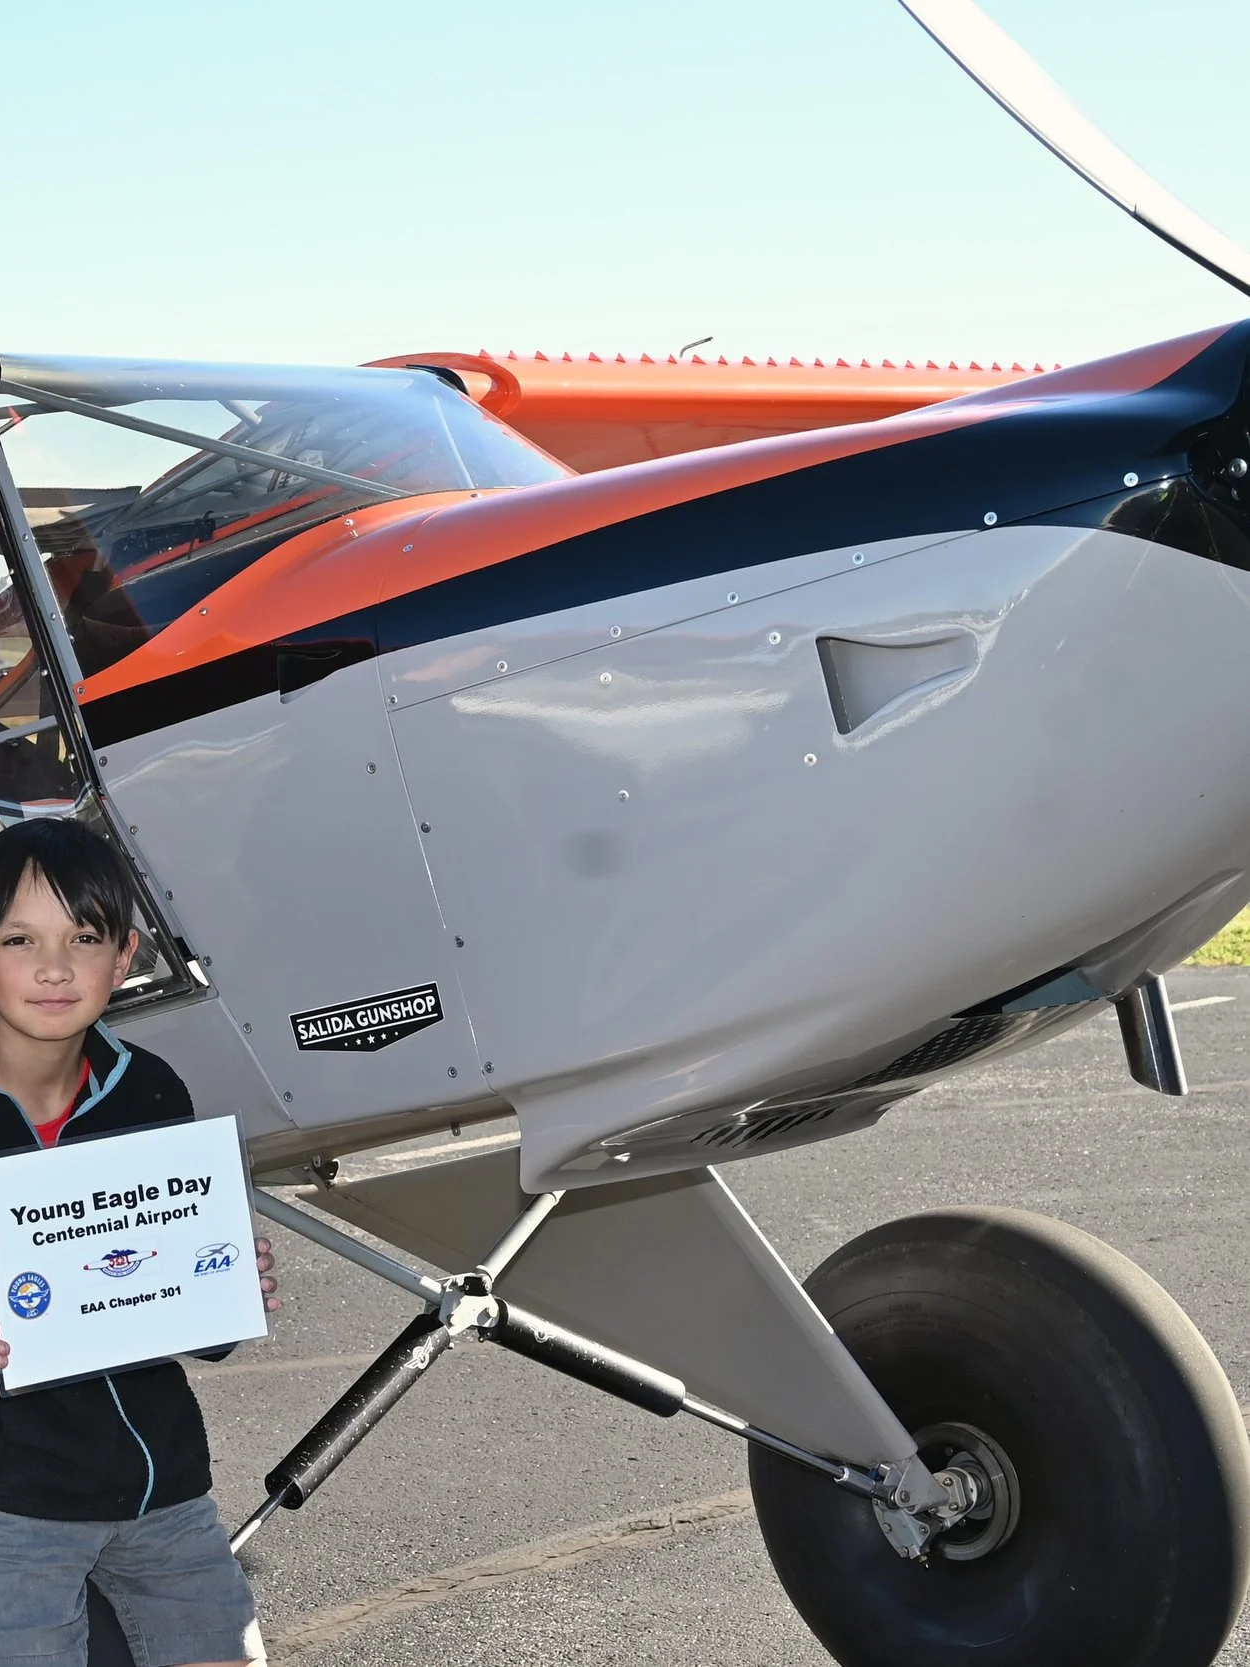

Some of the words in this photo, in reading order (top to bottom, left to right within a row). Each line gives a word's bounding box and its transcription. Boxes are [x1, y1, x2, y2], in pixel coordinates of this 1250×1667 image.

[297, 1014, 355, 1040] SALIDA
[356, 995, 436, 1027] GUNSHOP
[10, 1199, 85, 1226] Young
[92, 1183, 160, 1211] Eagle
[167, 1176, 212, 1196] Day
[32, 1215, 129, 1246] Centennial
[135, 1202, 199, 1227] Airport
[194, 1255, 230, 1273] EAA
[80, 1301, 106, 1315] EAA
[109, 1292, 157, 1308] Chapter
[160, 1285, 182, 1299] 301
